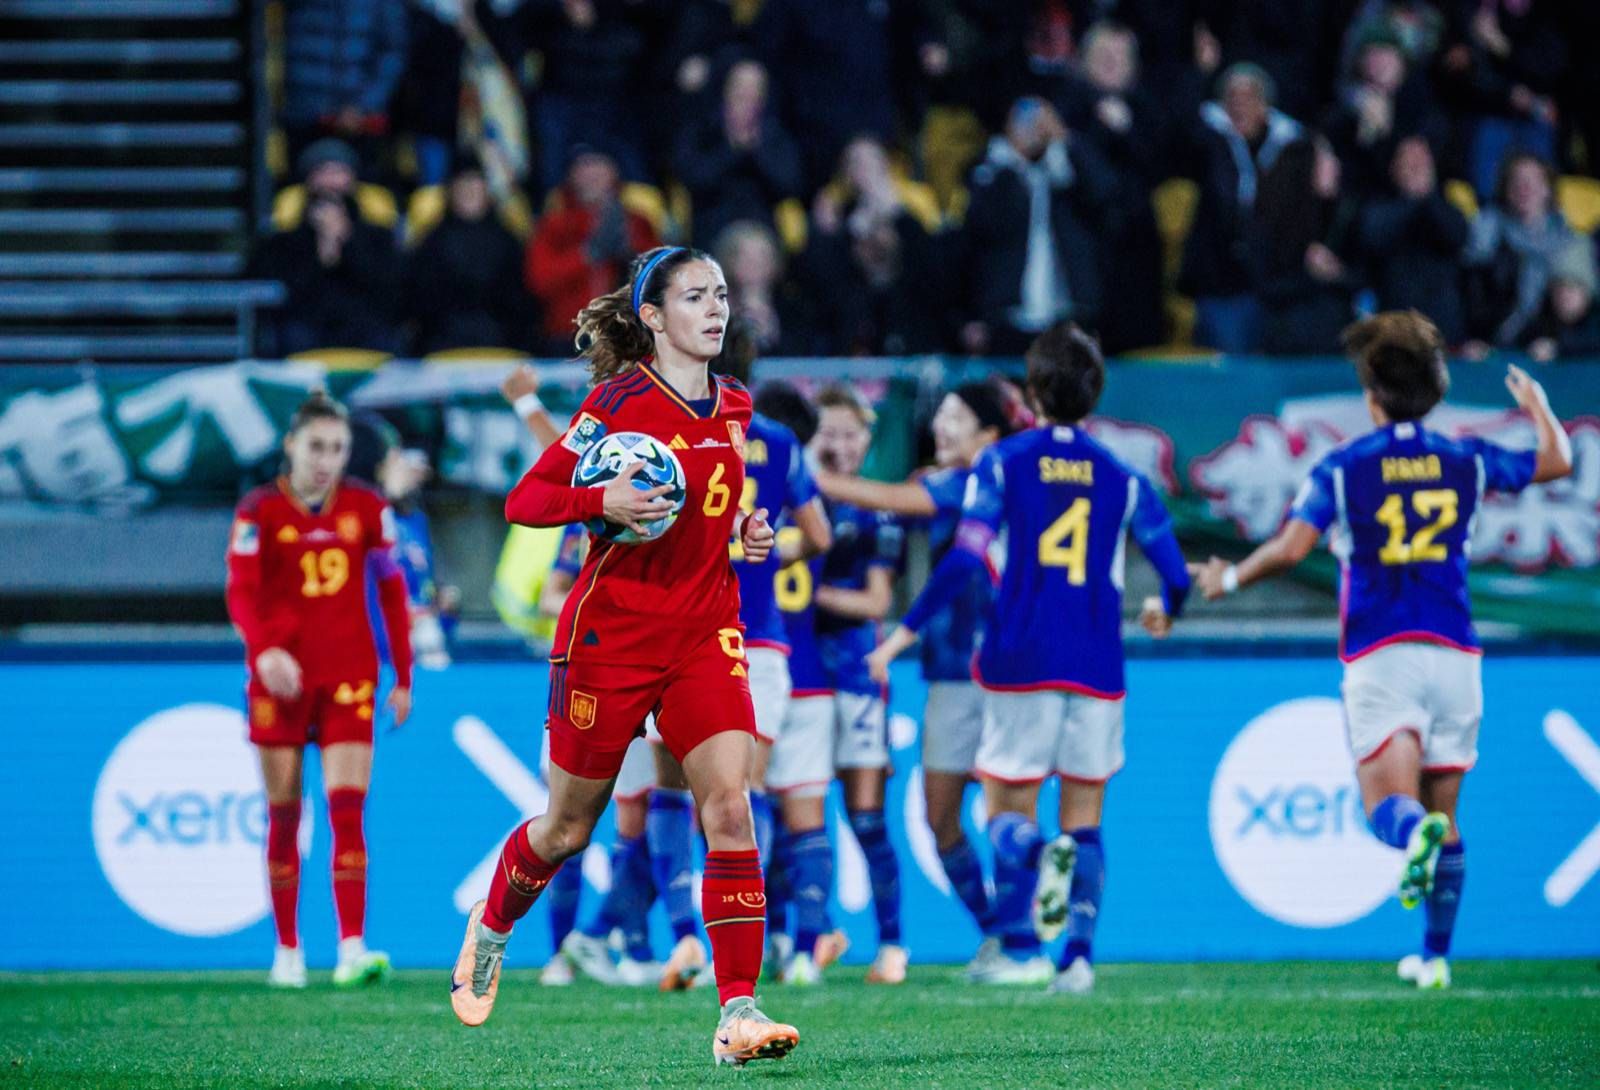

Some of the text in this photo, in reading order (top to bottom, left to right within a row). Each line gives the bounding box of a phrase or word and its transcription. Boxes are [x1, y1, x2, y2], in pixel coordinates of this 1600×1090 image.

[702, 462, 731, 517] 6
[1037, 455, 1094, 486] SAKI
[1037, 496, 1092, 587] 4
[1374, 487, 1459, 567] 12
[299, 546, 350, 598] 19
